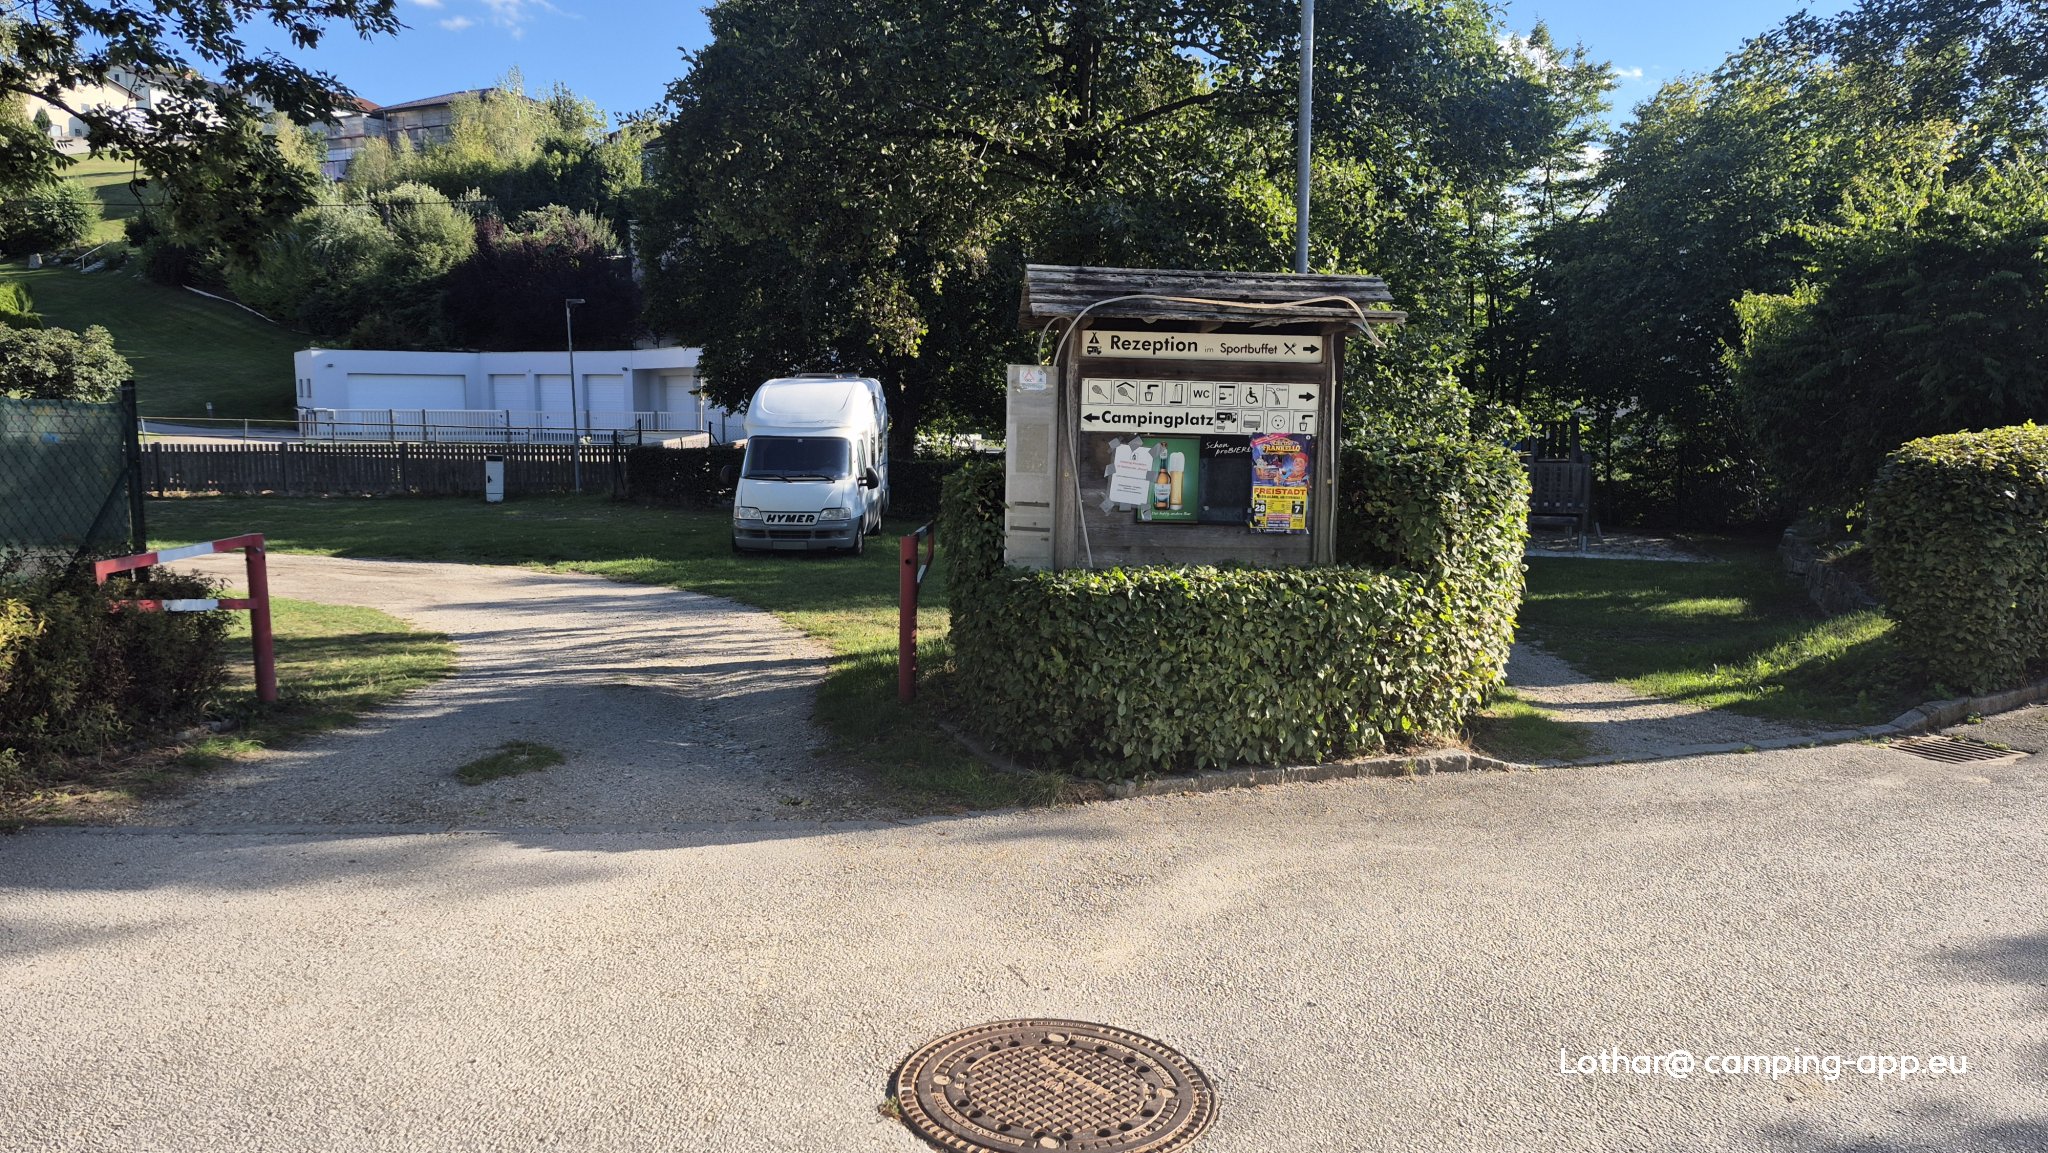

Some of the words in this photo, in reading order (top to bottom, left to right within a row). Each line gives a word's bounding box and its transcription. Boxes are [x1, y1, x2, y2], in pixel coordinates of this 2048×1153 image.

[1110, 335, 1198, 354] Rezeption
[1220, 343, 1278, 356] Sportbuffet
[1193, 389, 1210, 399] WC
[1101, 411, 1214, 427] Campingplatz
[1254, 504, 1266, 512] 28
[1294, 505, 1301, 513] 7
[766, 514, 815, 523] HYMER
